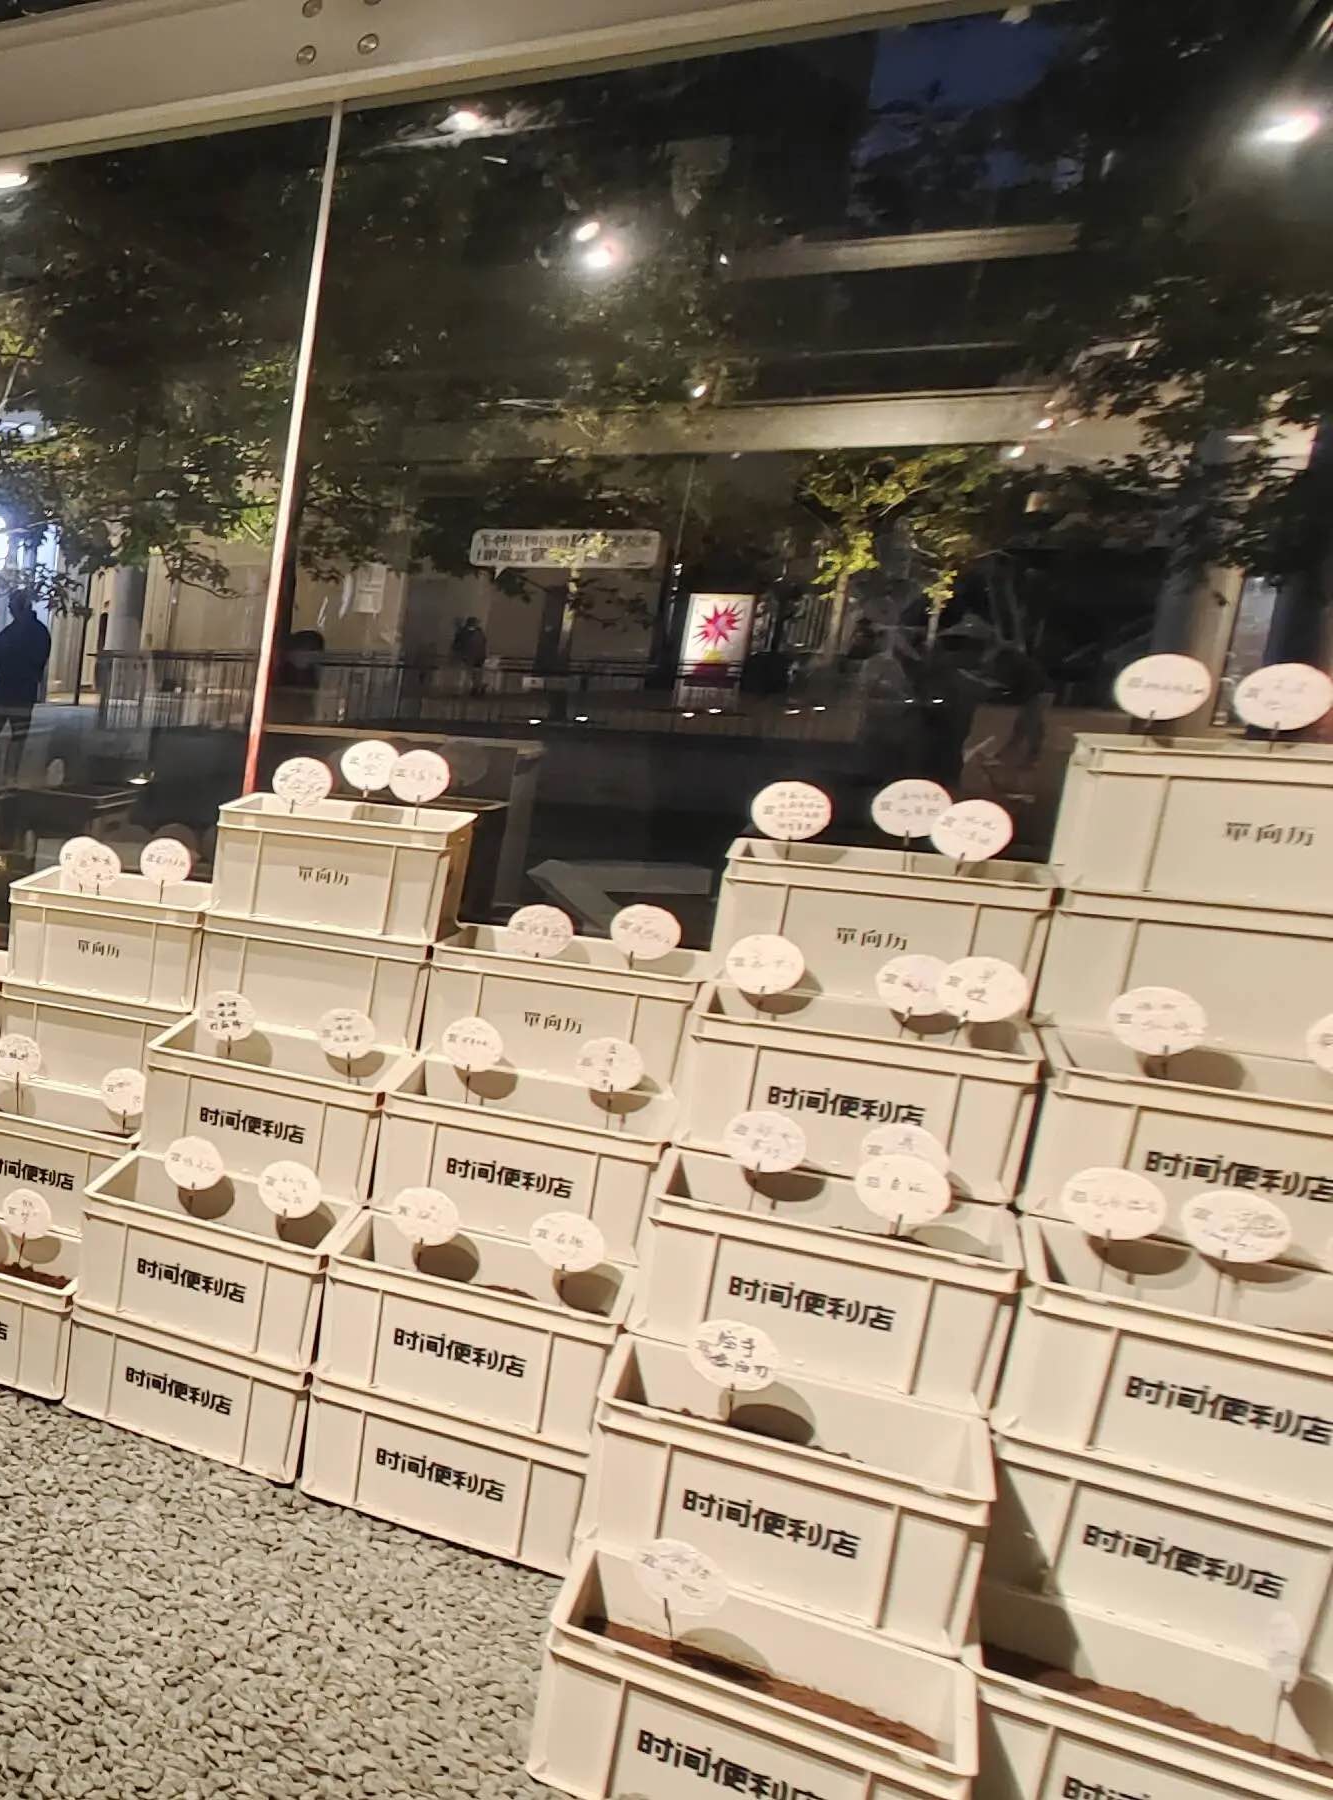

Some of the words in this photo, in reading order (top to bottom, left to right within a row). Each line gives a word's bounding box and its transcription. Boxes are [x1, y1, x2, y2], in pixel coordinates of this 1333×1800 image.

[200, 1107, 305, 1144] 时间便利店
[768, 1086, 925, 1126] 时间便利店
[447, 1158, 573, 1198] 时间便利店
[1145, 1151, 1333, 1202] 时间便利店
[137, 1257, 247, 1303] 时间便利店
[729, 1274, 896, 1331] 时间便利店
[394, 1328, 526, 1377] 时间便利店
[126, 1366, 233, 1415] 时间便利店
[1125, 1375, 1333, 1445] 时间便利店
[377, 1447, 507, 1501] 时间便利店
[683, 1488, 861, 1559] 时间便利店
[1083, 1523, 1288, 1599] 时间便利店
